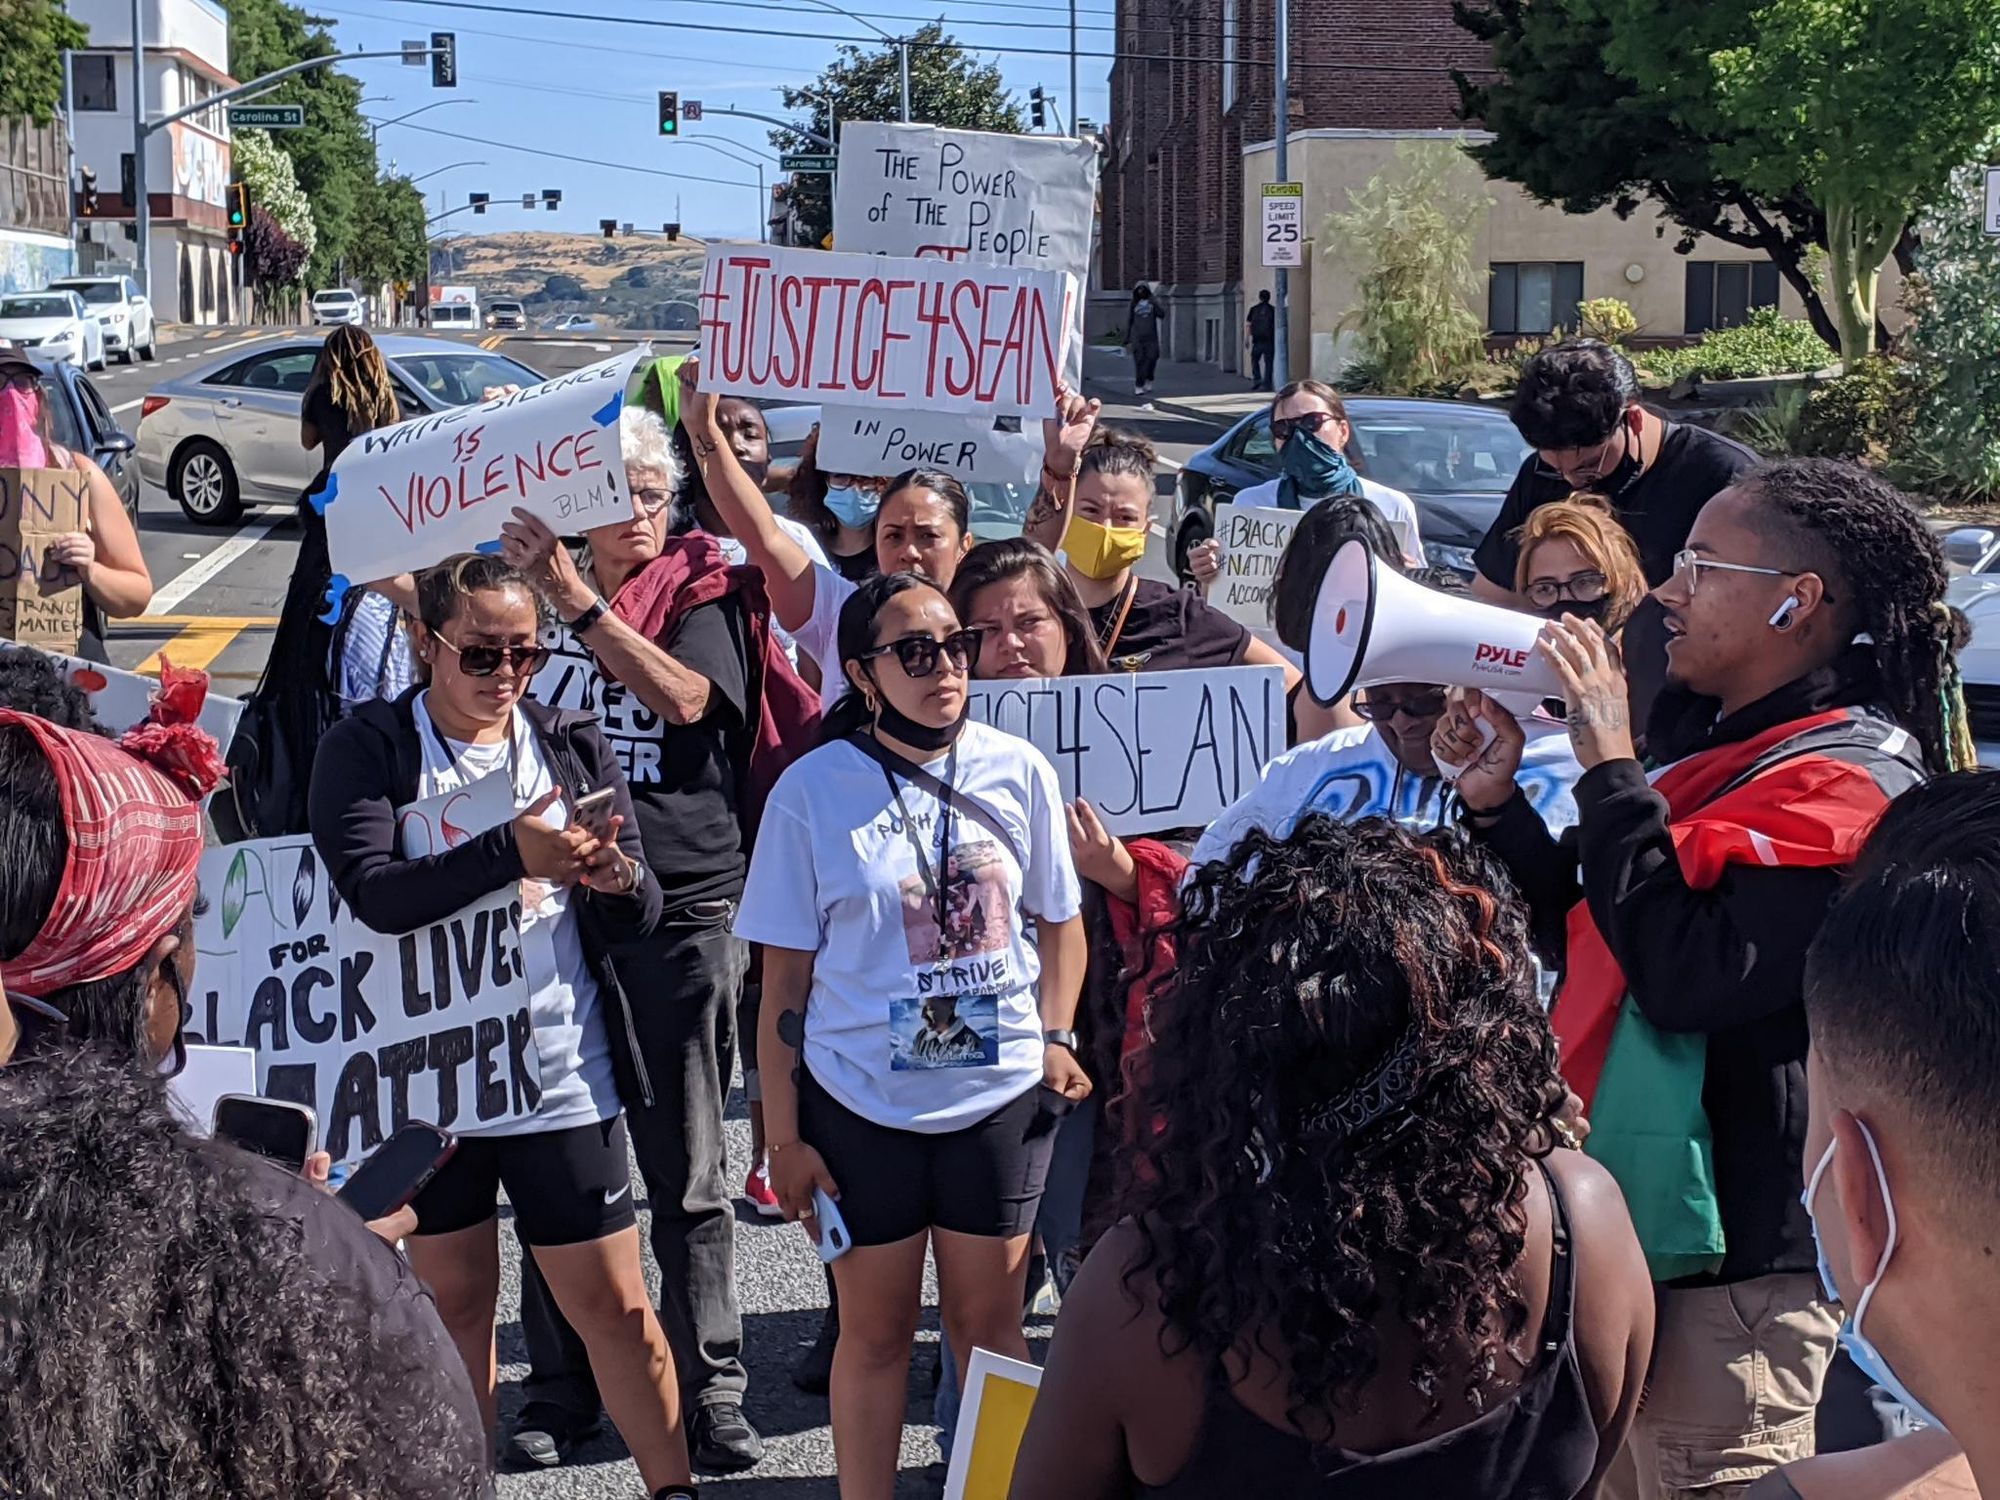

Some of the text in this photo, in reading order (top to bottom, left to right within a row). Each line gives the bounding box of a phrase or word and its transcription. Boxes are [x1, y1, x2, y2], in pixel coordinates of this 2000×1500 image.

[231, 111, 297, 122] Carolina St
[876, 149, 919, 180] THE
[1264, 185, 1300, 194] SCHOOL
[1268, 202, 1296, 210] SPEED
[868, 193, 892, 222] of
[907, 197, 948, 226] THE
[1268, 212, 1295, 221] LIMIT
[1266, 223, 1298, 242] 25
[699, 257, 1071, 405] #JUSTICE4SEAN
[451, 424, 487, 463] IS
[854, 420, 881, 437] IN
[881, 427, 977, 471] POWER
[378, 430, 602, 534] VIOLENCE
[0, 473, 91, 530] NY
[1217, 515, 1287, 549] #BLACK
[1475, 643, 1531, 668] PYLE
[532, 664, 660, 731] IVES
[269, 934, 330, 971] FOR
